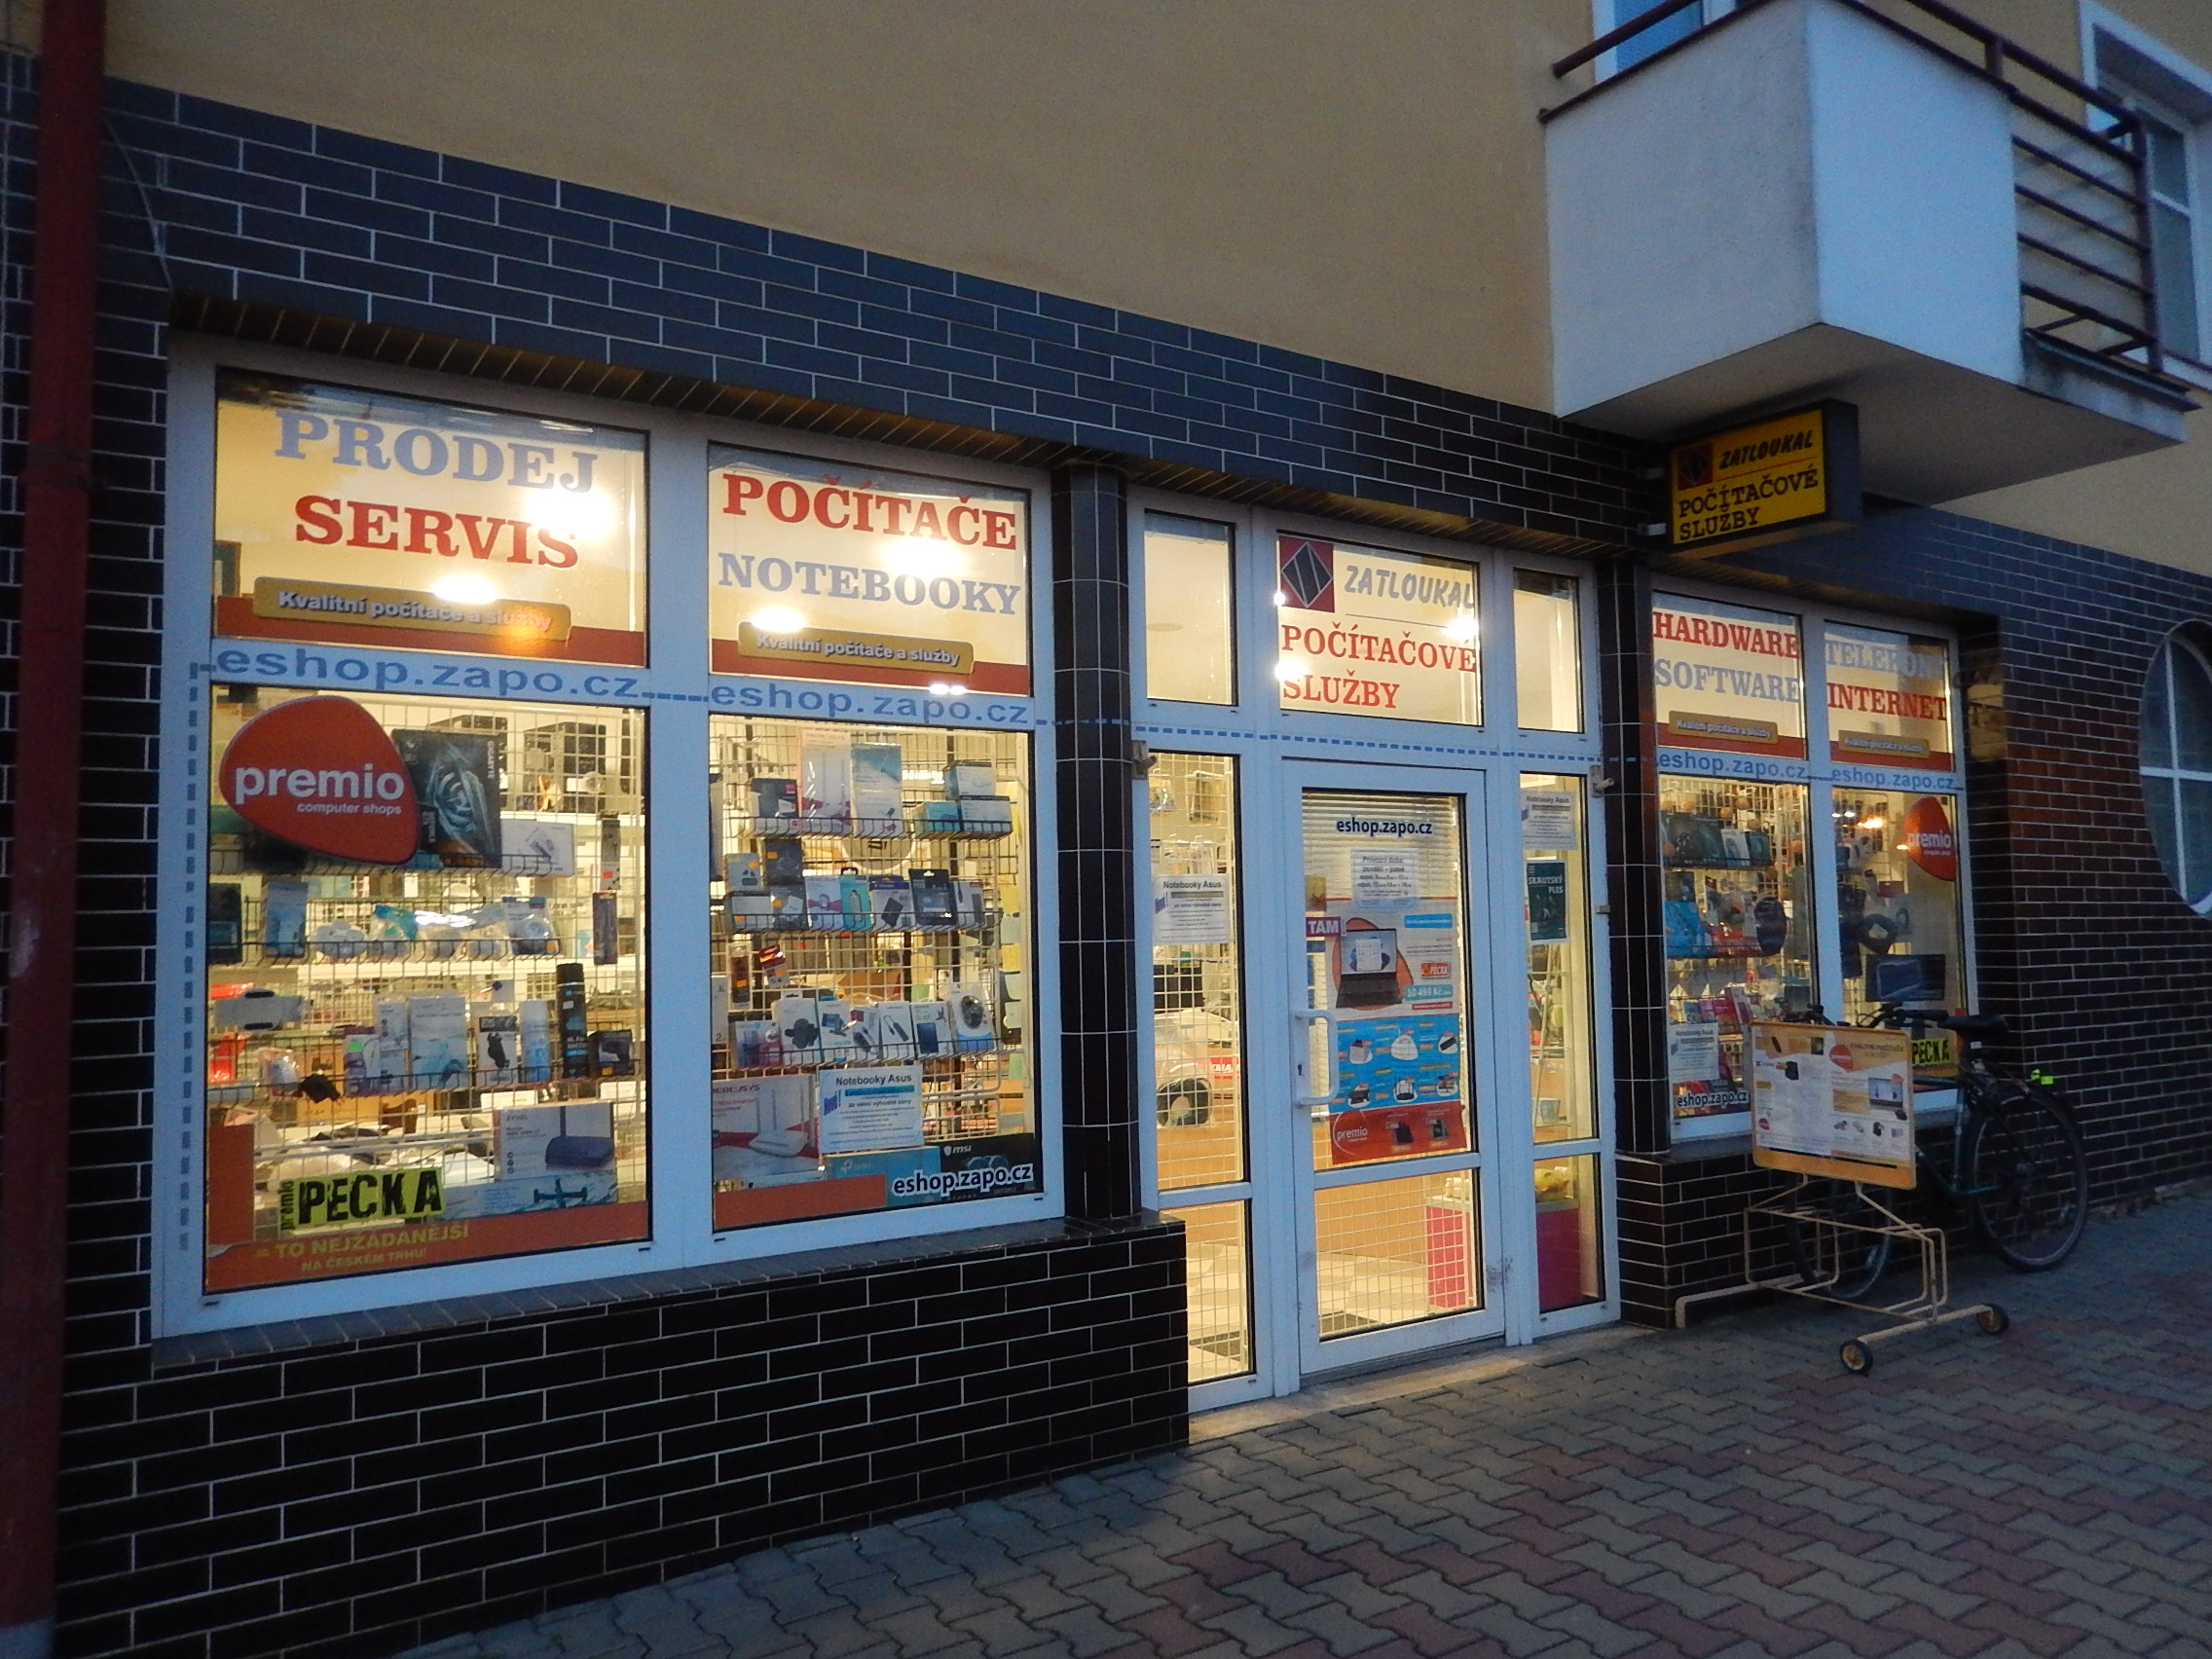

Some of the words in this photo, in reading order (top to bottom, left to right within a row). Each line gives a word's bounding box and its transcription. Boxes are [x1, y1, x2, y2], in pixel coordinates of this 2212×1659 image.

[275, 410, 598, 493] PRODEJ
[1719, 430, 1813, 469] ZATLOUKAL
[1679, 463, 1818, 517] POČÍTAČOVÉ
[722, 473, 1016, 550] POČÍTAČE
[1679, 507, 1760, 540] SLUŽBY
[295, 496, 578, 569] SERVIS
[718, 552, 1020, 614] NOTEBOOKY
[1344, 565, 1475, 608] ZATLOUKAL
[278, 590, 367, 613] Kvalitní
[756, 633, 822, 653] Kvalitní
[825, 640, 893, 661] počítače
[910, 645, 960, 668] služby
[1281, 621, 1477, 673] POČÍTAČOVÉ
[1652, 611, 1800, 658] HARDWARE
[217, 646, 639, 699] eshop.zapo.cz
[1282, 670, 1400, 709] SLUŽBY
[1655, 658, 1801, 703] SOFTWARE
[710, 682, 1028, 723] eshop.zapo.cz
[1827, 682, 1947, 720] INTERNET
[1659, 752, 1805, 779] eshop.zapo.cz
[1831, 767, 1953, 790] eshop.zapo.cz
[235, 763, 405, 805] premio
[297, 803, 359, 815] computer
[363, 803, 402, 815] shops
[1337, 817, 1433, 837] eshop.zapo.cz
[1906, 830, 1952, 850] premio
[1308, 920, 1339, 934] TAM
[1912, 1039, 1950, 1064] PECKA
[835, 1076, 886, 1086] Notebooky
[888, 1074, 912, 1083] Asus
[1677, 1091, 1748, 1108] eshop.zapo.cz
[952, 1145, 972, 1154] msi
[1337, 1125, 1368, 1141] premio
[298, 1170, 442, 1224] PECKA
[894, 1164, 1031, 1195] eshop.zapo.cz
[275, 1244, 306, 1260] TO
